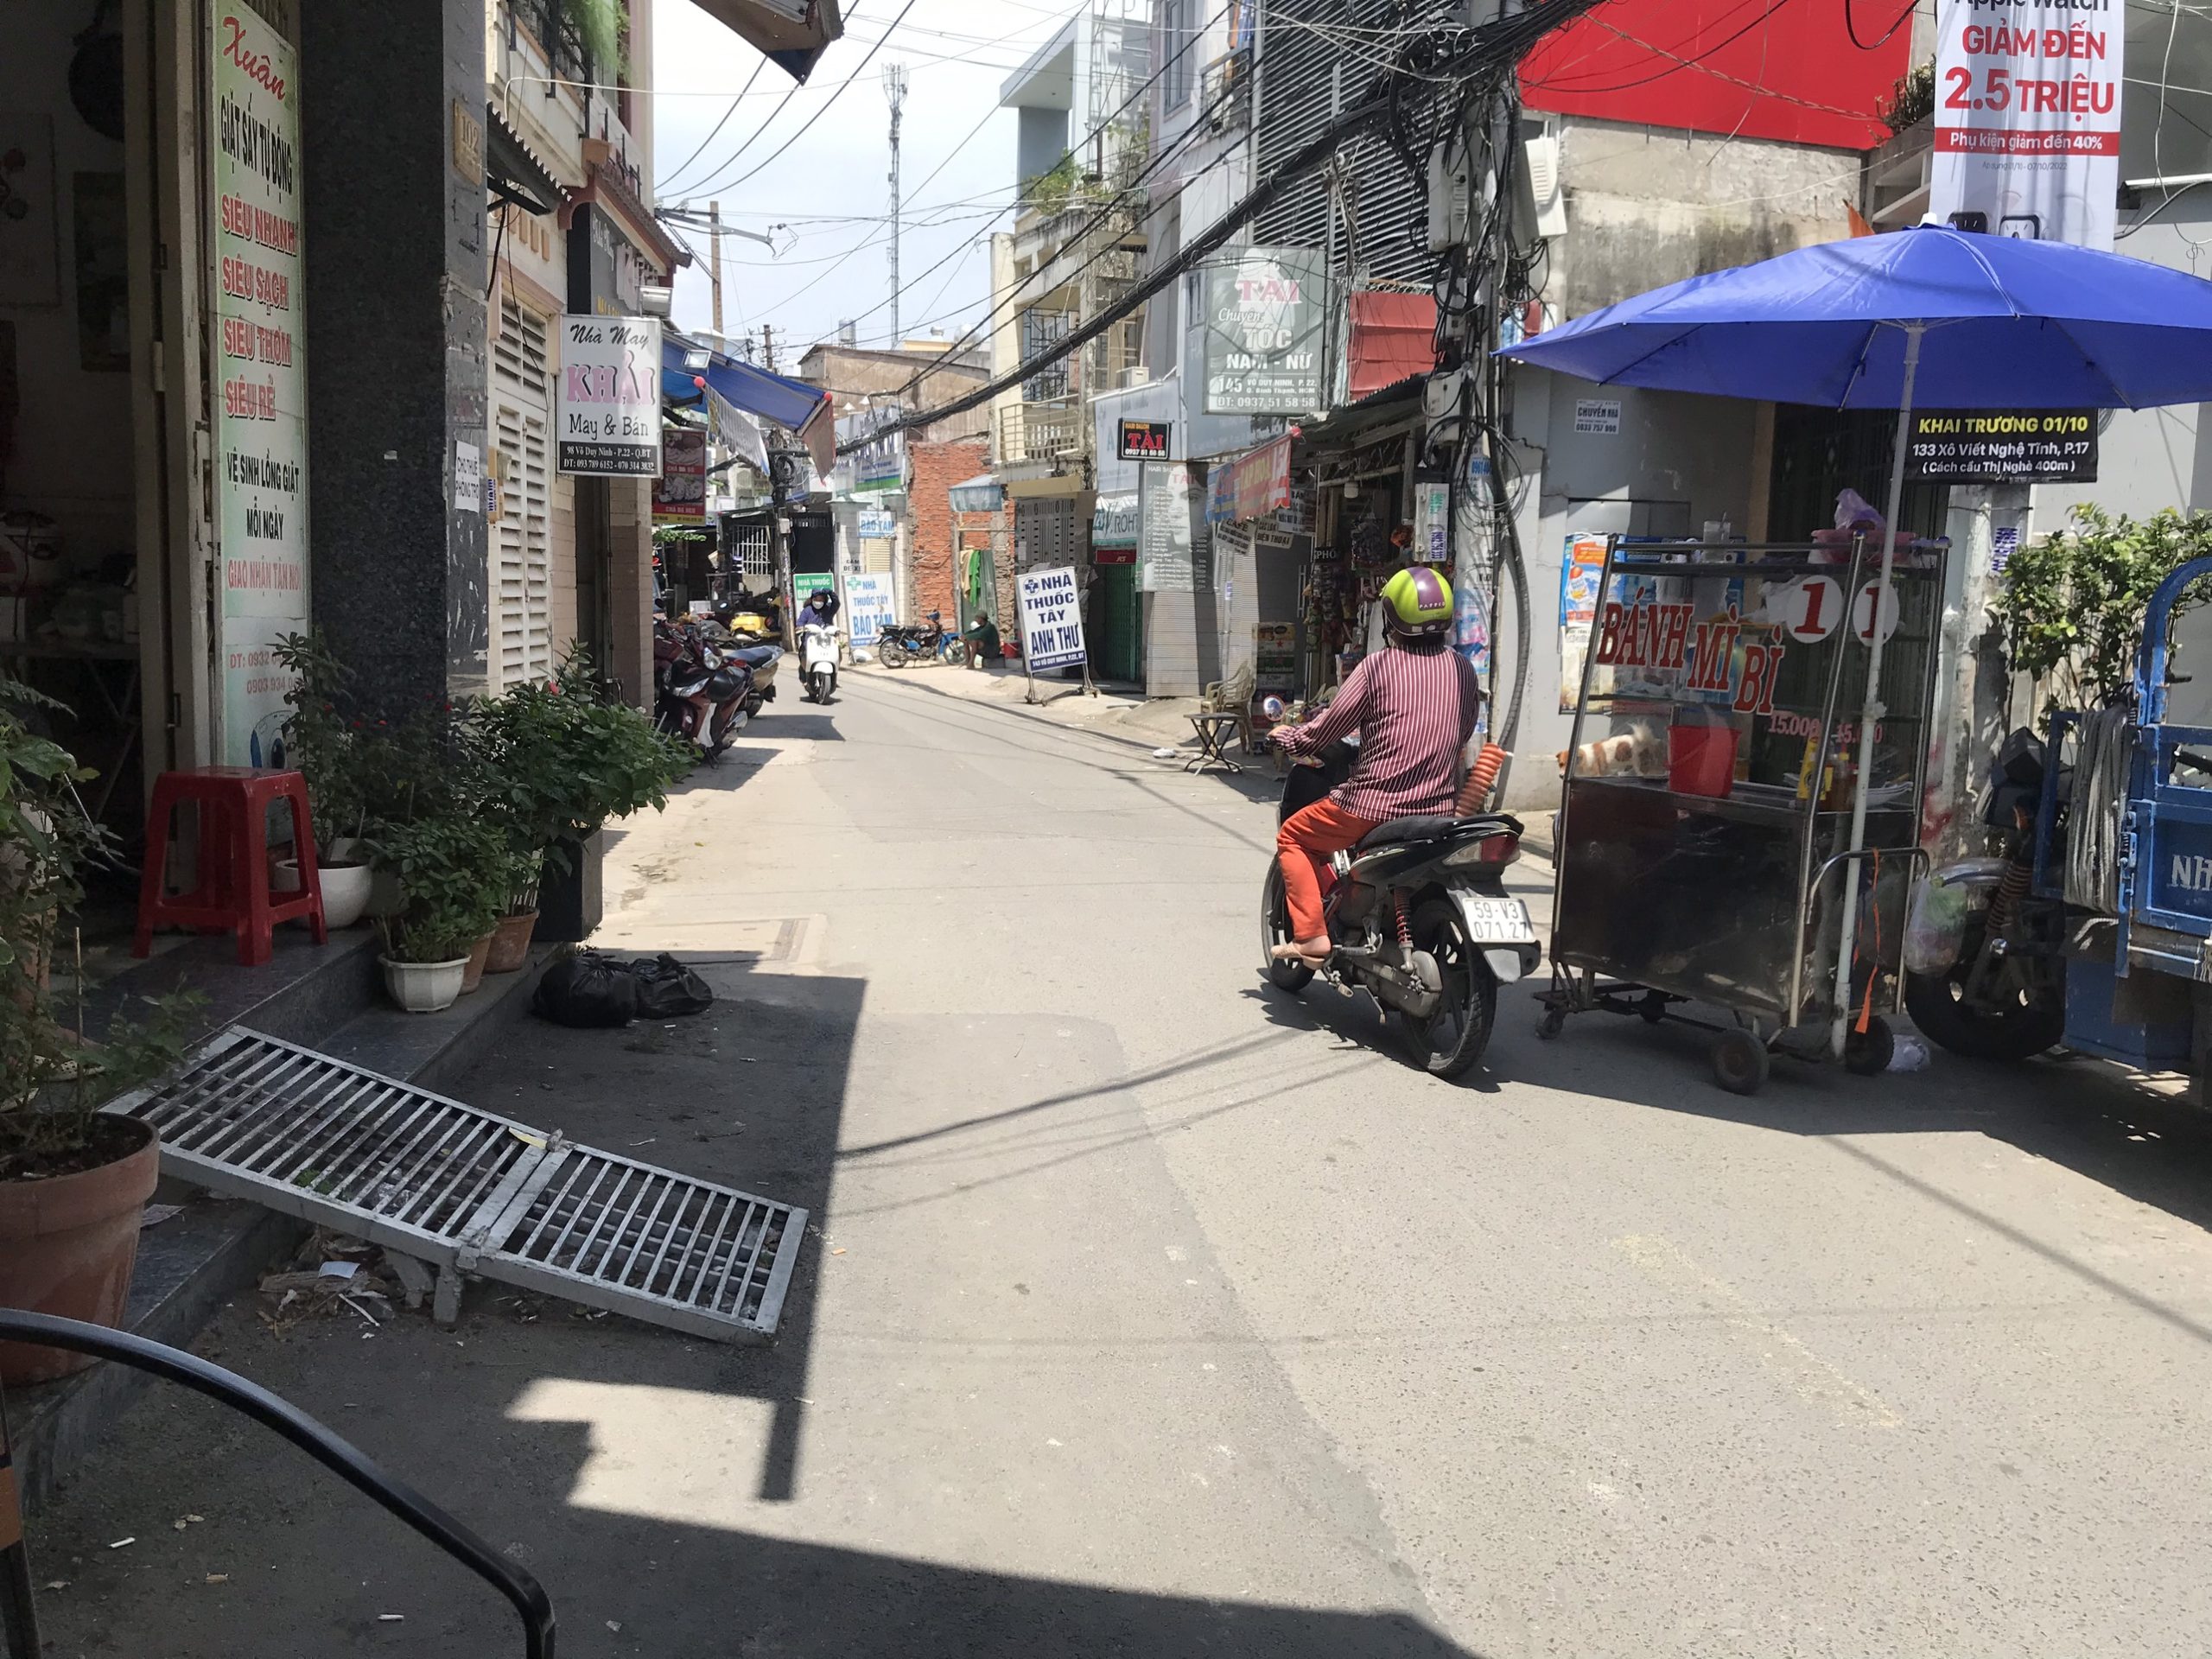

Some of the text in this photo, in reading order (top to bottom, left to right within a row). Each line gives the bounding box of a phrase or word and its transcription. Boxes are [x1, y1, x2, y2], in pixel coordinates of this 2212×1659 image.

[1962, 17, 2106, 60] GIẢM ĐẾN
[223, 16, 285, 100] Xuân
[1944, 67, 2113, 122] 2.5 TRIỆU
[220, 87, 240, 174] GIẶT
[242, 92, 257, 172] SẤY
[1950, 131, 2102, 152] Phụ kiện giảm đến 40%
[221, 192, 296, 257] SIÊU NHANH
[222, 253, 289, 316] SIÊU SẠCH
[1218, 308, 1262, 325] Chuyên
[224, 315, 292, 367] SIÊU THƠM
[570, 324, 649, 349] Nhà May
[1243, 322, 1293, 349] TÓC
[226, 373, 276, 422] SIÊU RẺ
[1237, 397, 1265, 407] 0937
[1268, 397, 1281, 407] 51
[1285, 397, 1299, 407] 58
[1301, 397, 1315, 407] 58
[569, 413, 648, 441] May & Bán
[1128, 429, 1164, 449] TÀI
[1919, 416, 2088, 435] KHAI TRƯƠNG 01/10
[567, 446, 575, 455] 98
[575, 446, 584, 456] Võ
[585, 446, 597, 458] Duy
[598, 446, 613, 457] Ninh
[1912, 442, 2089, 459] 133 Xô Viết Nghệ Tĩnh, P.17
[227, 446, 300, 502] VỆ SINH LỒNG GIẶT
[576, 459, 588, 468] 093
[588, 459, 599, 468] 789
[600, 460, 613, 469] 6152
[618, 461, 628, 470] 070
[629, 461, 640, 471] 314
[1960, 461, 1980, 473] cầu
[1983, 461, 2000, 474] Thị
[2004, 461, 2032, 473] Nghè
[2035, 460, 2069, 472] 400m
[246, 495, 283, 540] MỖI NGÀY
[228, 559, 248, 589] GIAO
[1040, 571, 1073, 591] NHÀ
[1025, 589, 1074, 611] THUỐC
[1794, 582, 1826, 635] 1
[1039, 608, 1065, 624] TÂY
[1596, 586, 1694, 669] BÁNH
[1031, 622, 1081, 656] ANH THƯ
